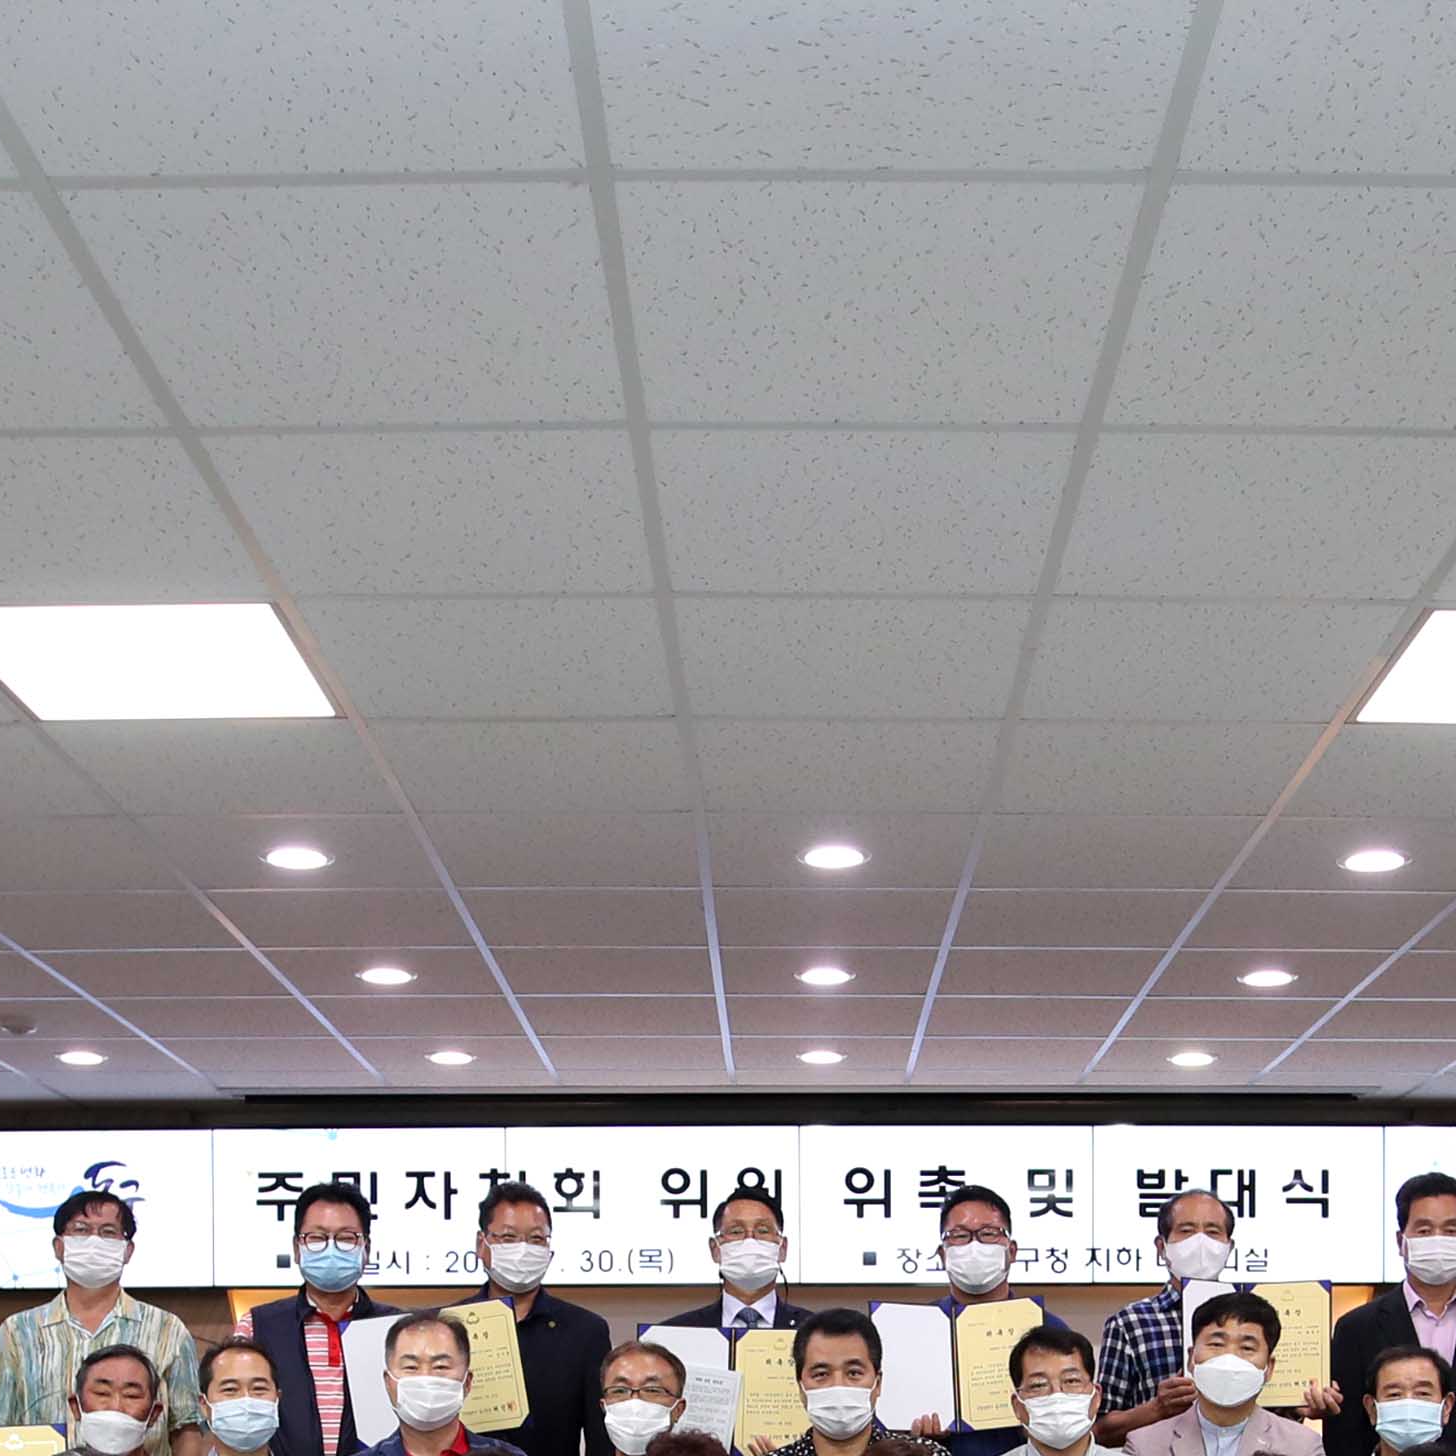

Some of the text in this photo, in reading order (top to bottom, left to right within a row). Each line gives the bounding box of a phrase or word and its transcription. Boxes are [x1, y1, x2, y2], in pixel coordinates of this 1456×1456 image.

[1026, 1168, 1074, 1218] 및
[1136, 1168, 1330, 1219] 발대식
[1085, 1246, 1143, 1272] 지하
